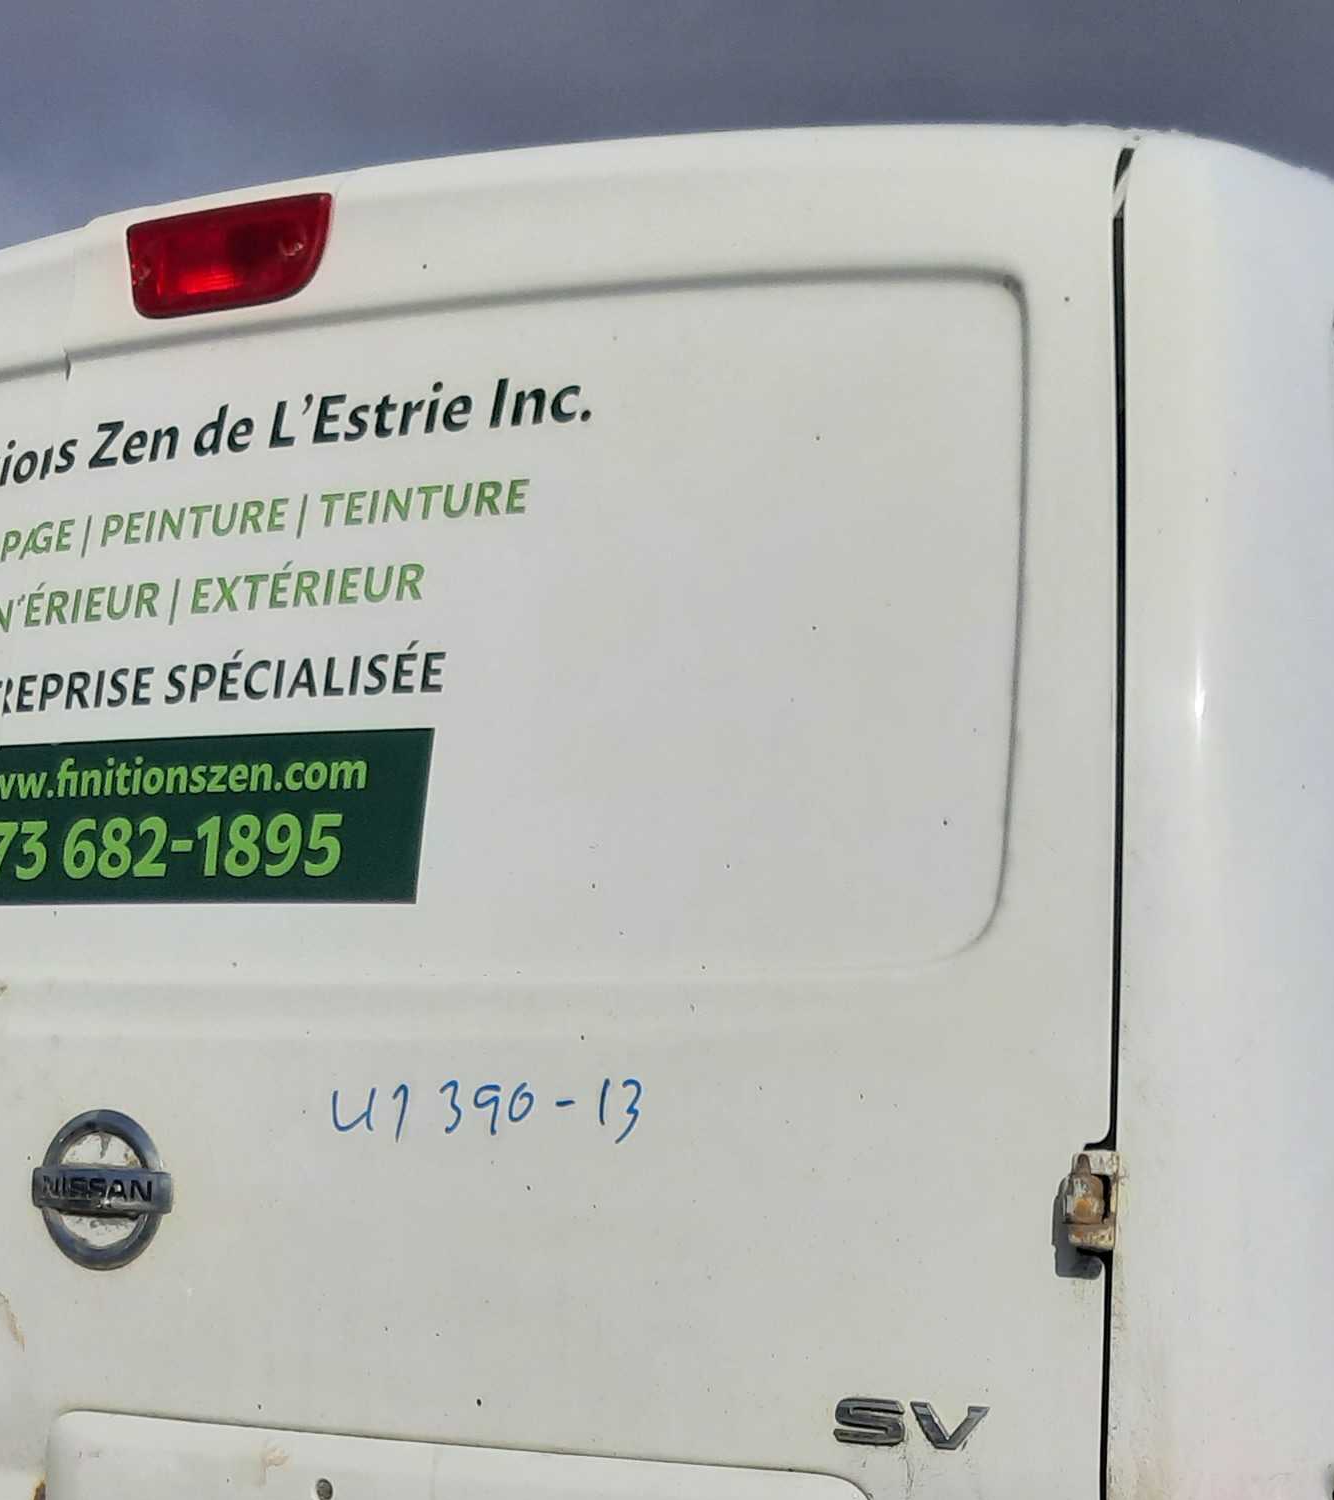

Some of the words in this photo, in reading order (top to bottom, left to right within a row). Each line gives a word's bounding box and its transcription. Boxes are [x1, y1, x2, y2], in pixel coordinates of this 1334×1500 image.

[88, 420, 181, 469] Zen
[193, 404, 254, 457] de
[269, 381, 473, 448] L'Estrie
[489, 377, 592, 429] Inc.
[100, 497, 288, 548] PEINTURE
[320, 479, 531, 529] TEINTURE
[190, 560, 425, 615] EXTÉRIEUR
[164, 639, 447, 705] SPÉCIALISÉE
[62, 812, 344, 881] 682-1895
[41, 1172, 154, 1203] NISSAN
[832, 1396, 991, 1451] SV
